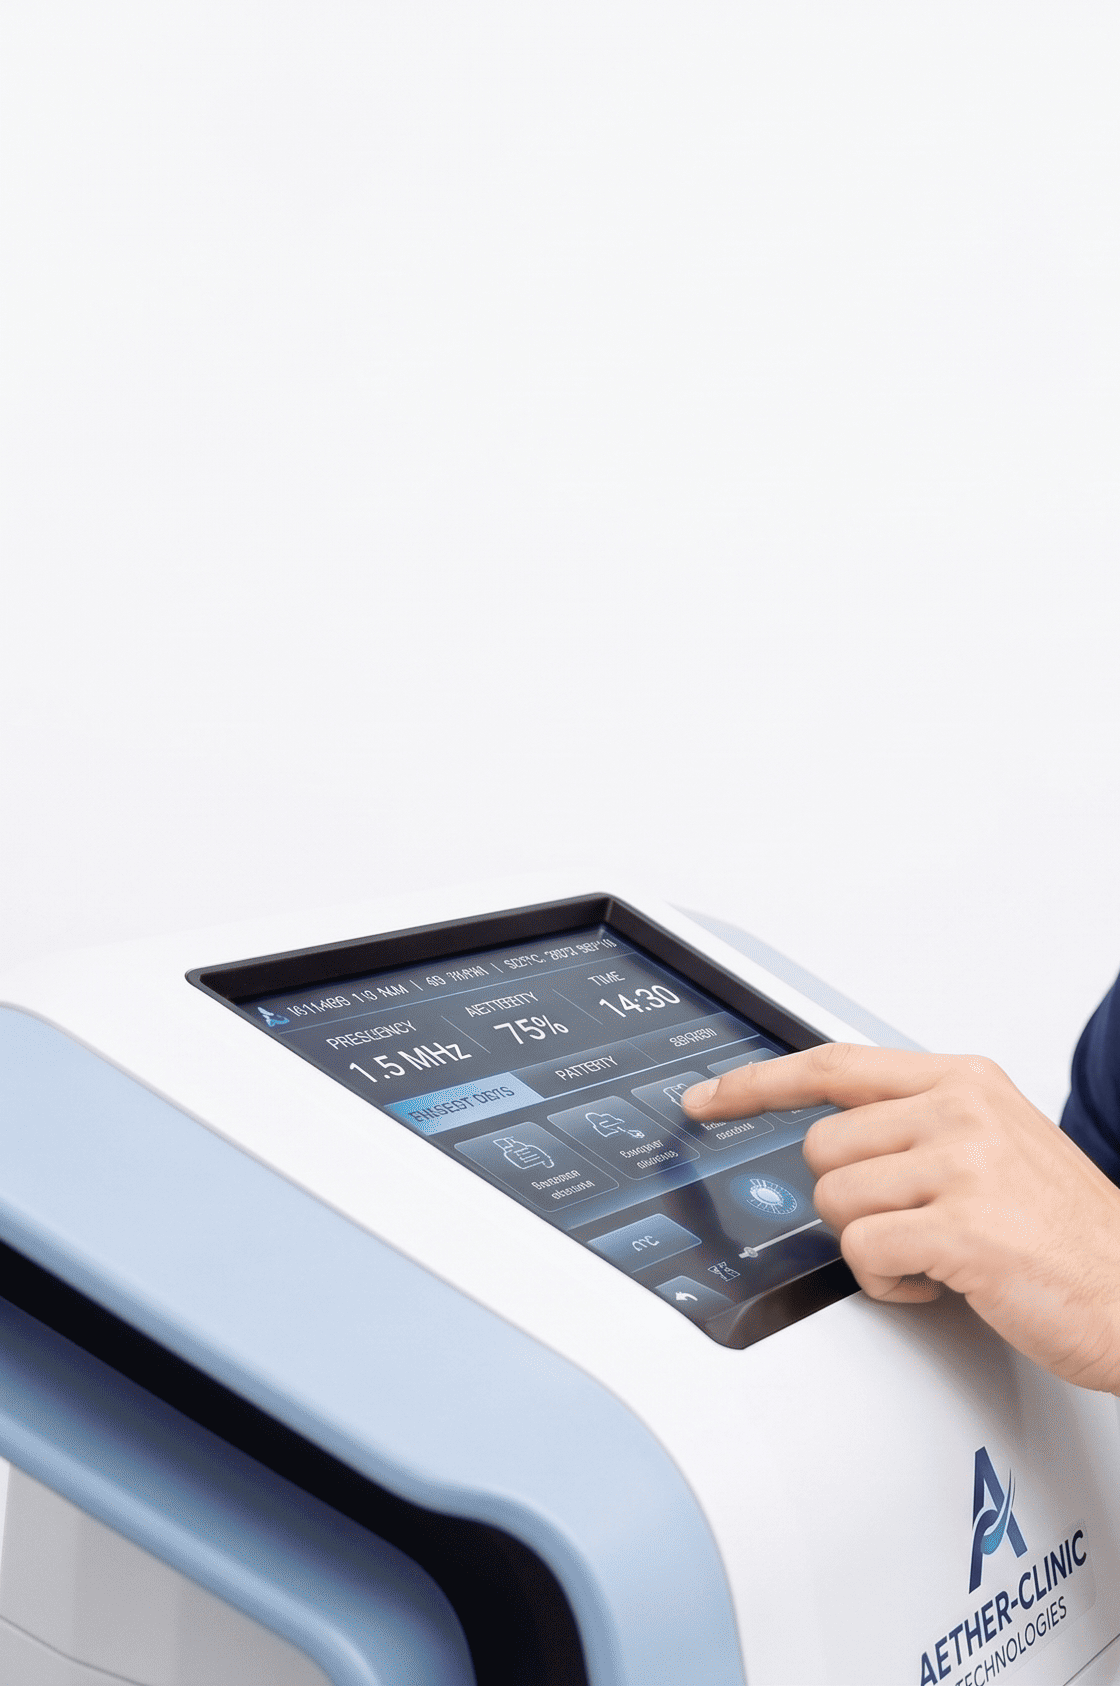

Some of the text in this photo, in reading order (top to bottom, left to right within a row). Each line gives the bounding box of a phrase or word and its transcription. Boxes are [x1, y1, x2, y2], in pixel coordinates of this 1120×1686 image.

[587, 970, 625, 987] TIME
[599, 984, 681, 1018] 14:30
[493, 1014, 569, 1045] 75%
[349, 1042, 472, 1083] 1.5 MHz
[920, 1529, 1087, 1686] AETHER-CLINIC
